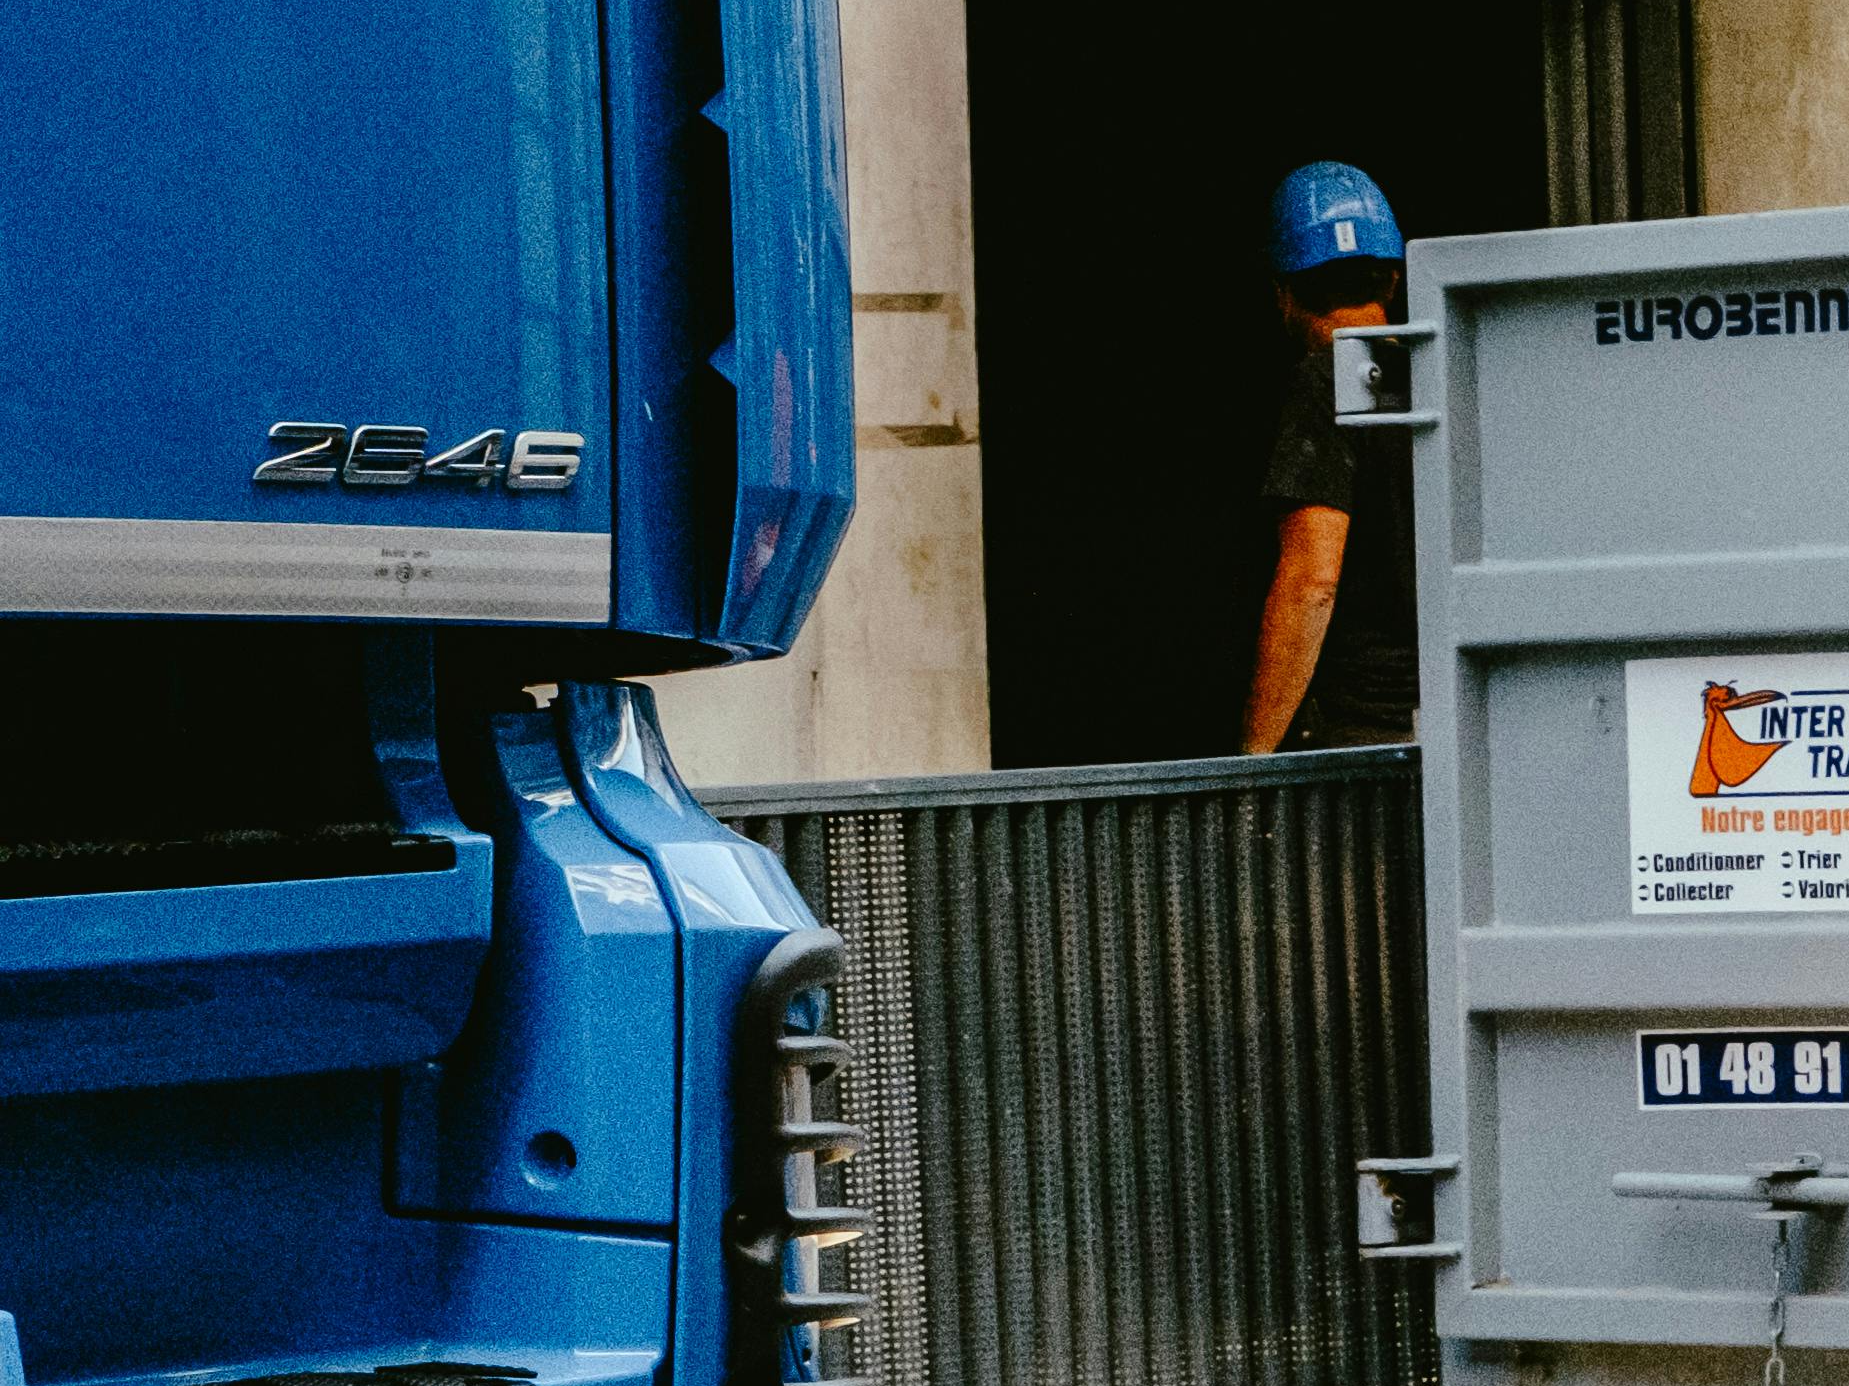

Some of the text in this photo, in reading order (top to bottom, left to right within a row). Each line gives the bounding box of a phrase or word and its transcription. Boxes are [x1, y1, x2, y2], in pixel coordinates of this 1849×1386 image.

[1760, 705, 1845, 740] INTER
[1701, 806, 1765, 834] Notre
[1653, 852, 1765, 873] Conditionner
[1798, 850, 1842, 869] Trier
[1654, 882, 1734, 902] Collecter
[1655, 1043, 1701, 1096] 01
[1719, 1042, 1776, 1095] 48
[1794, 1041, 1842, 1094] 91
